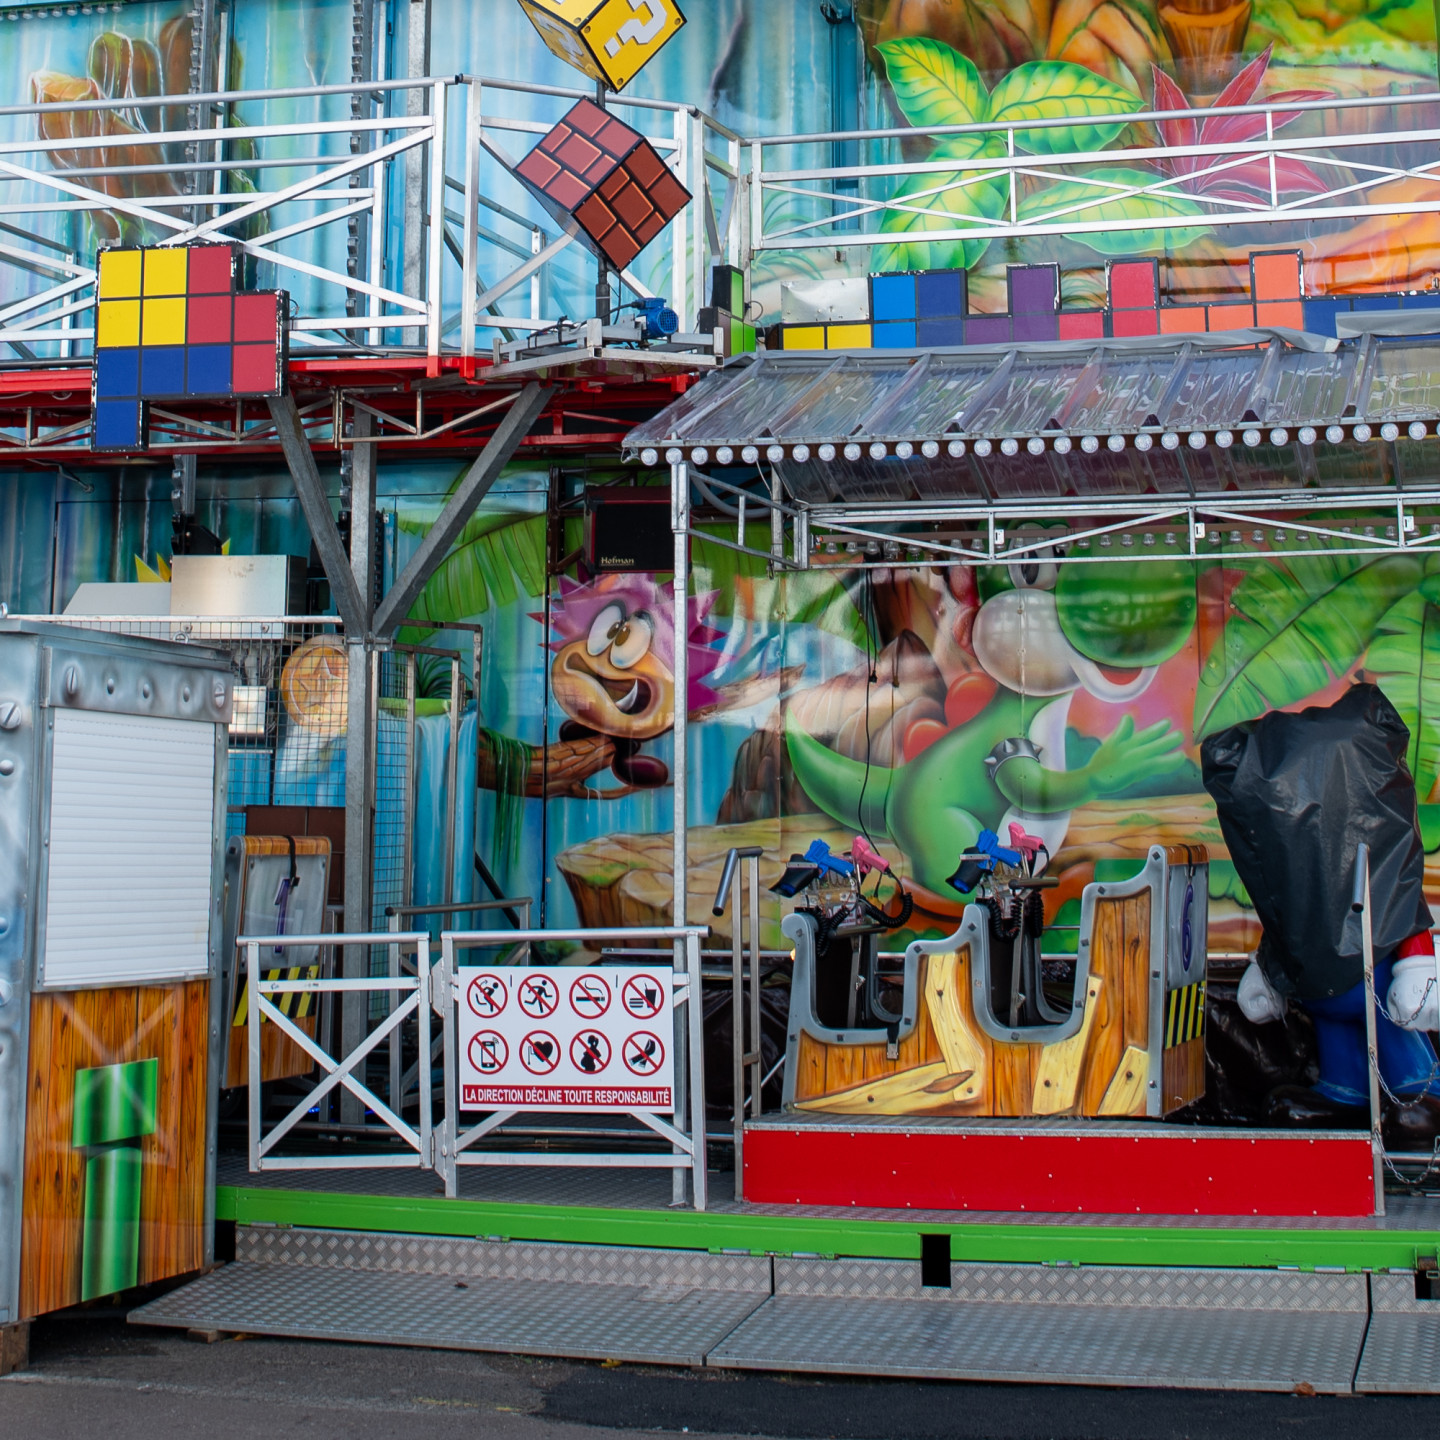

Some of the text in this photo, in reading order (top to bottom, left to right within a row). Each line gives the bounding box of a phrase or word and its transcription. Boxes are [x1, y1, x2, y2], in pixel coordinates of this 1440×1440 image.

[465, 1087, 670, 1105] LA DIRECTION DÉCLINE TOUTE RESPONSABILITÉ
